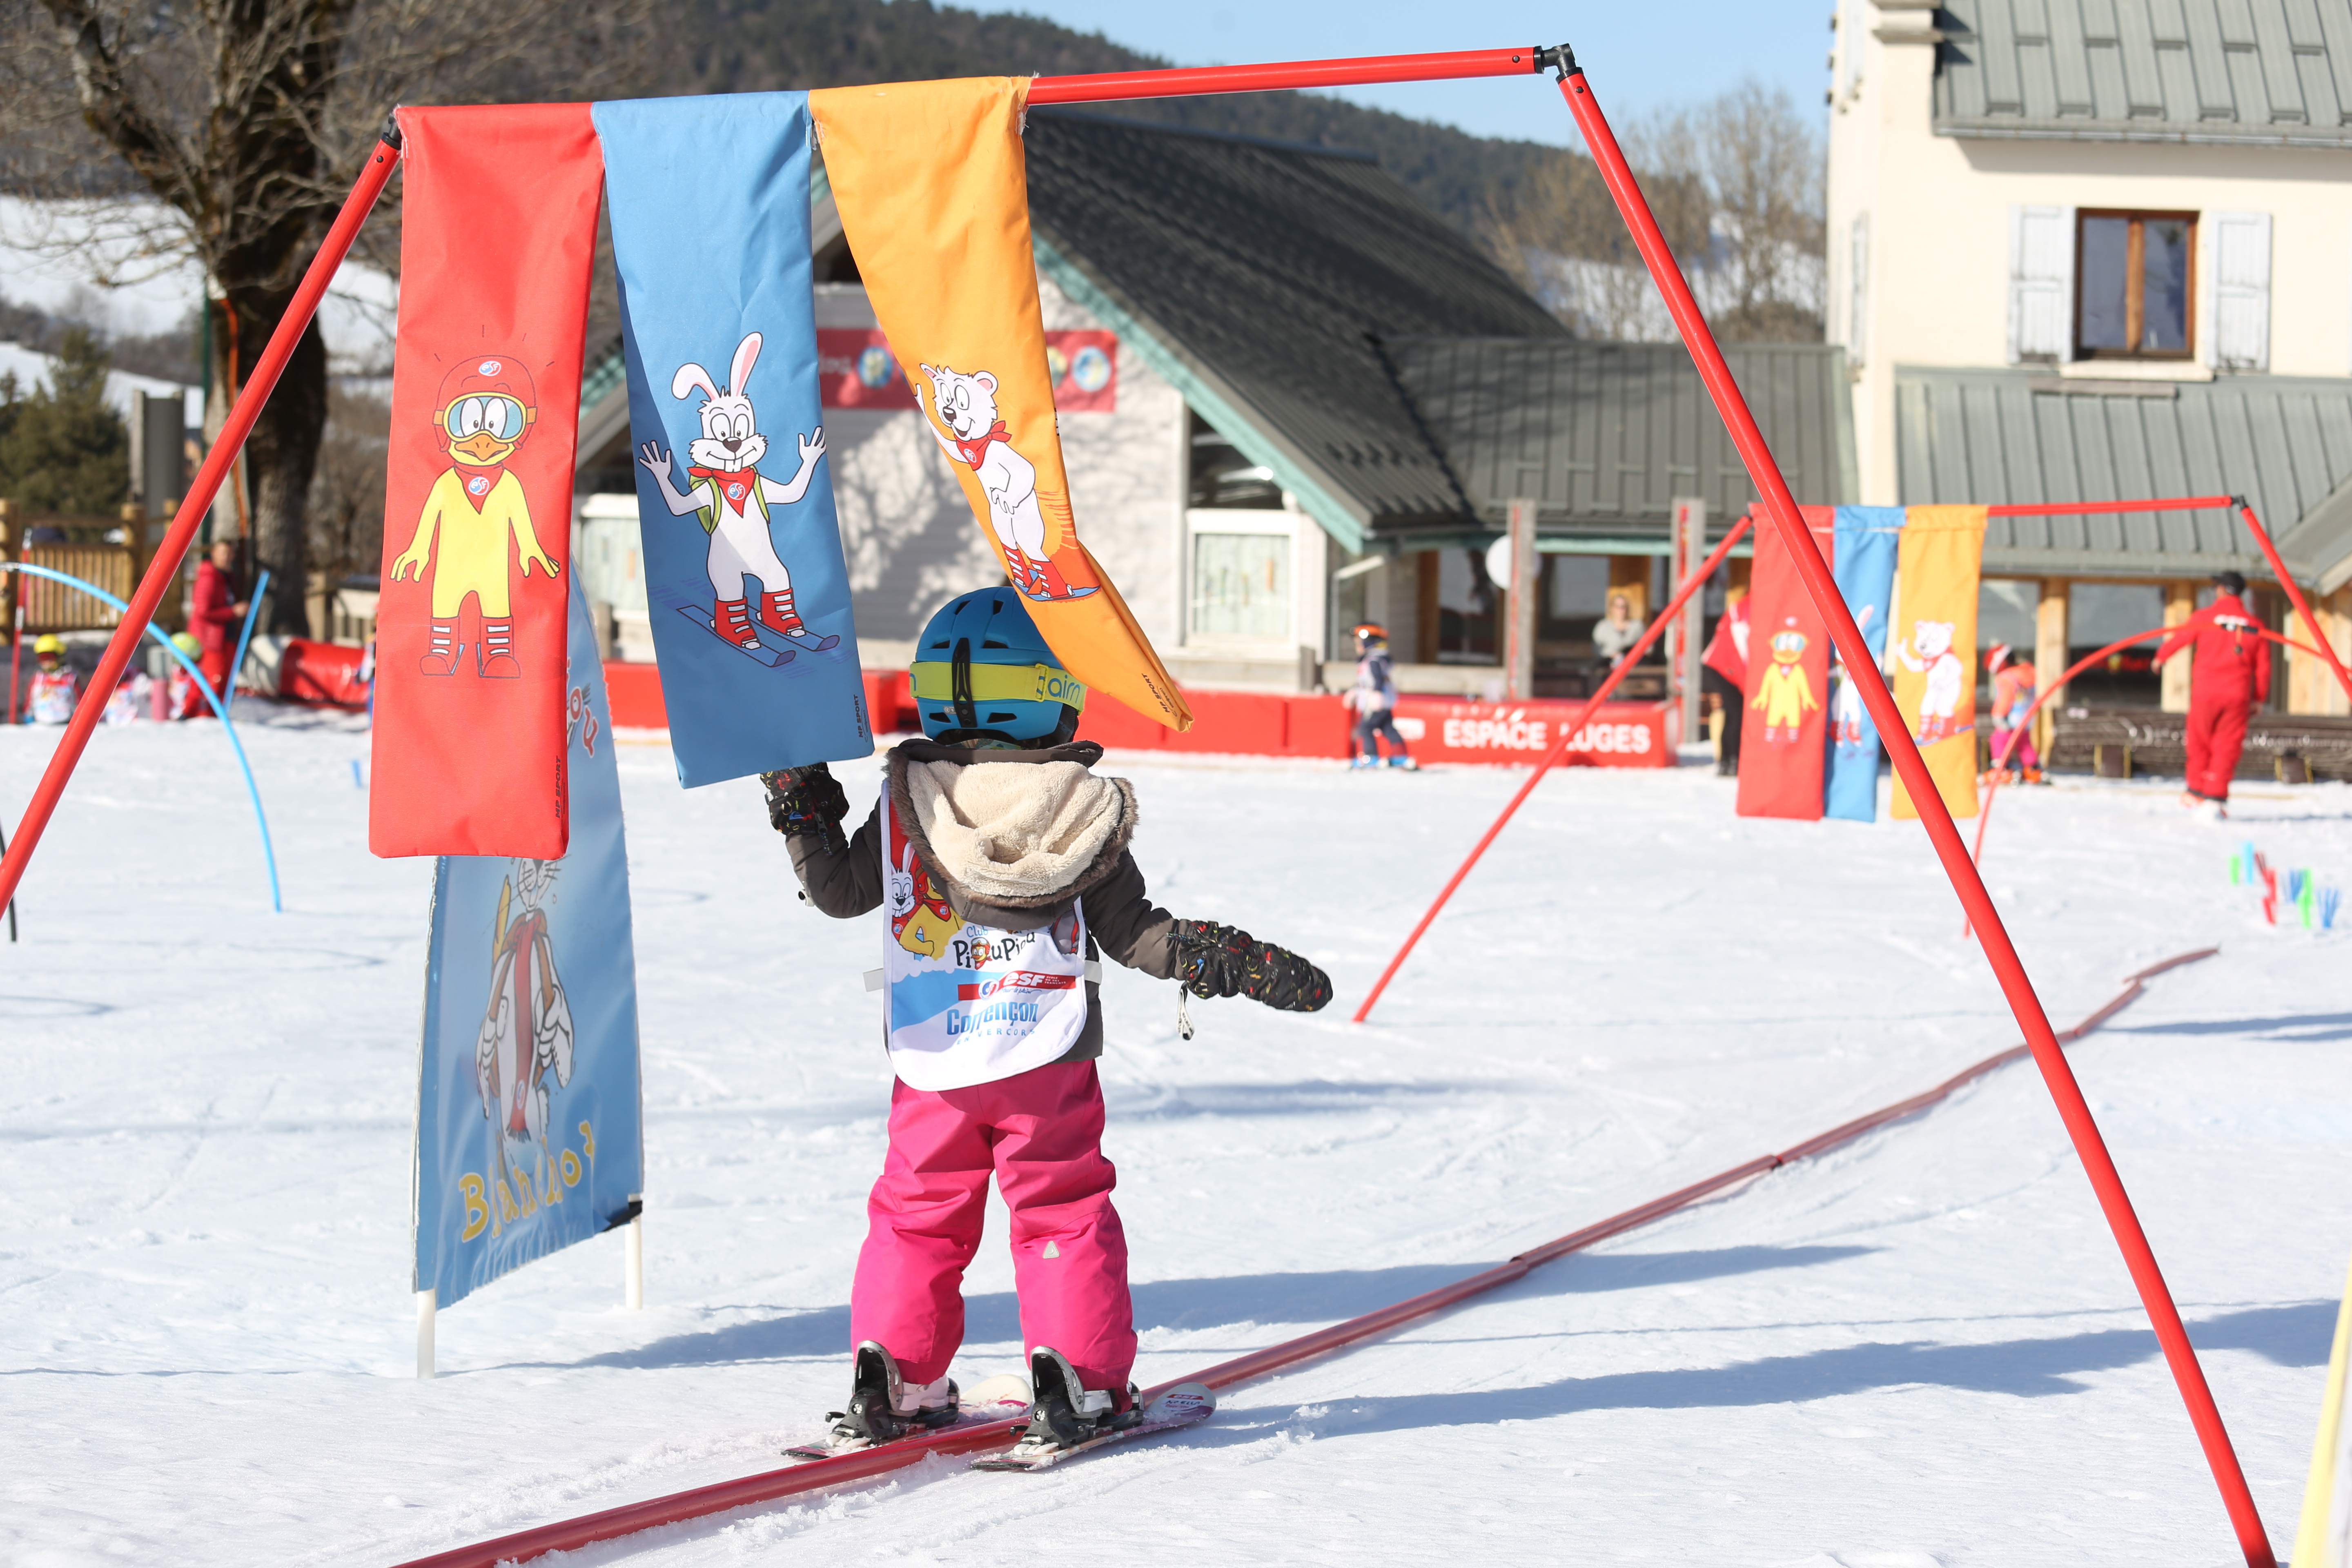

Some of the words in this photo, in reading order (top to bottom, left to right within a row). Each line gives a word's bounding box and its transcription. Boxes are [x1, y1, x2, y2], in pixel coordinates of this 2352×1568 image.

[1141, 673, 1161, 699] SPORT
[853, 694, 862, 724] SPORT
[1159, 701, 1170, 713] MP
[858, 725, 863, 737] MP
[1443, 718, 1548, 750] ESPACE
[556, 800, 561, 818] MP
[967, 925, 988, 938] Club
[957, 1036, 970, 1045] EN
[978, 1028, 1035, 1038] VERCORS
